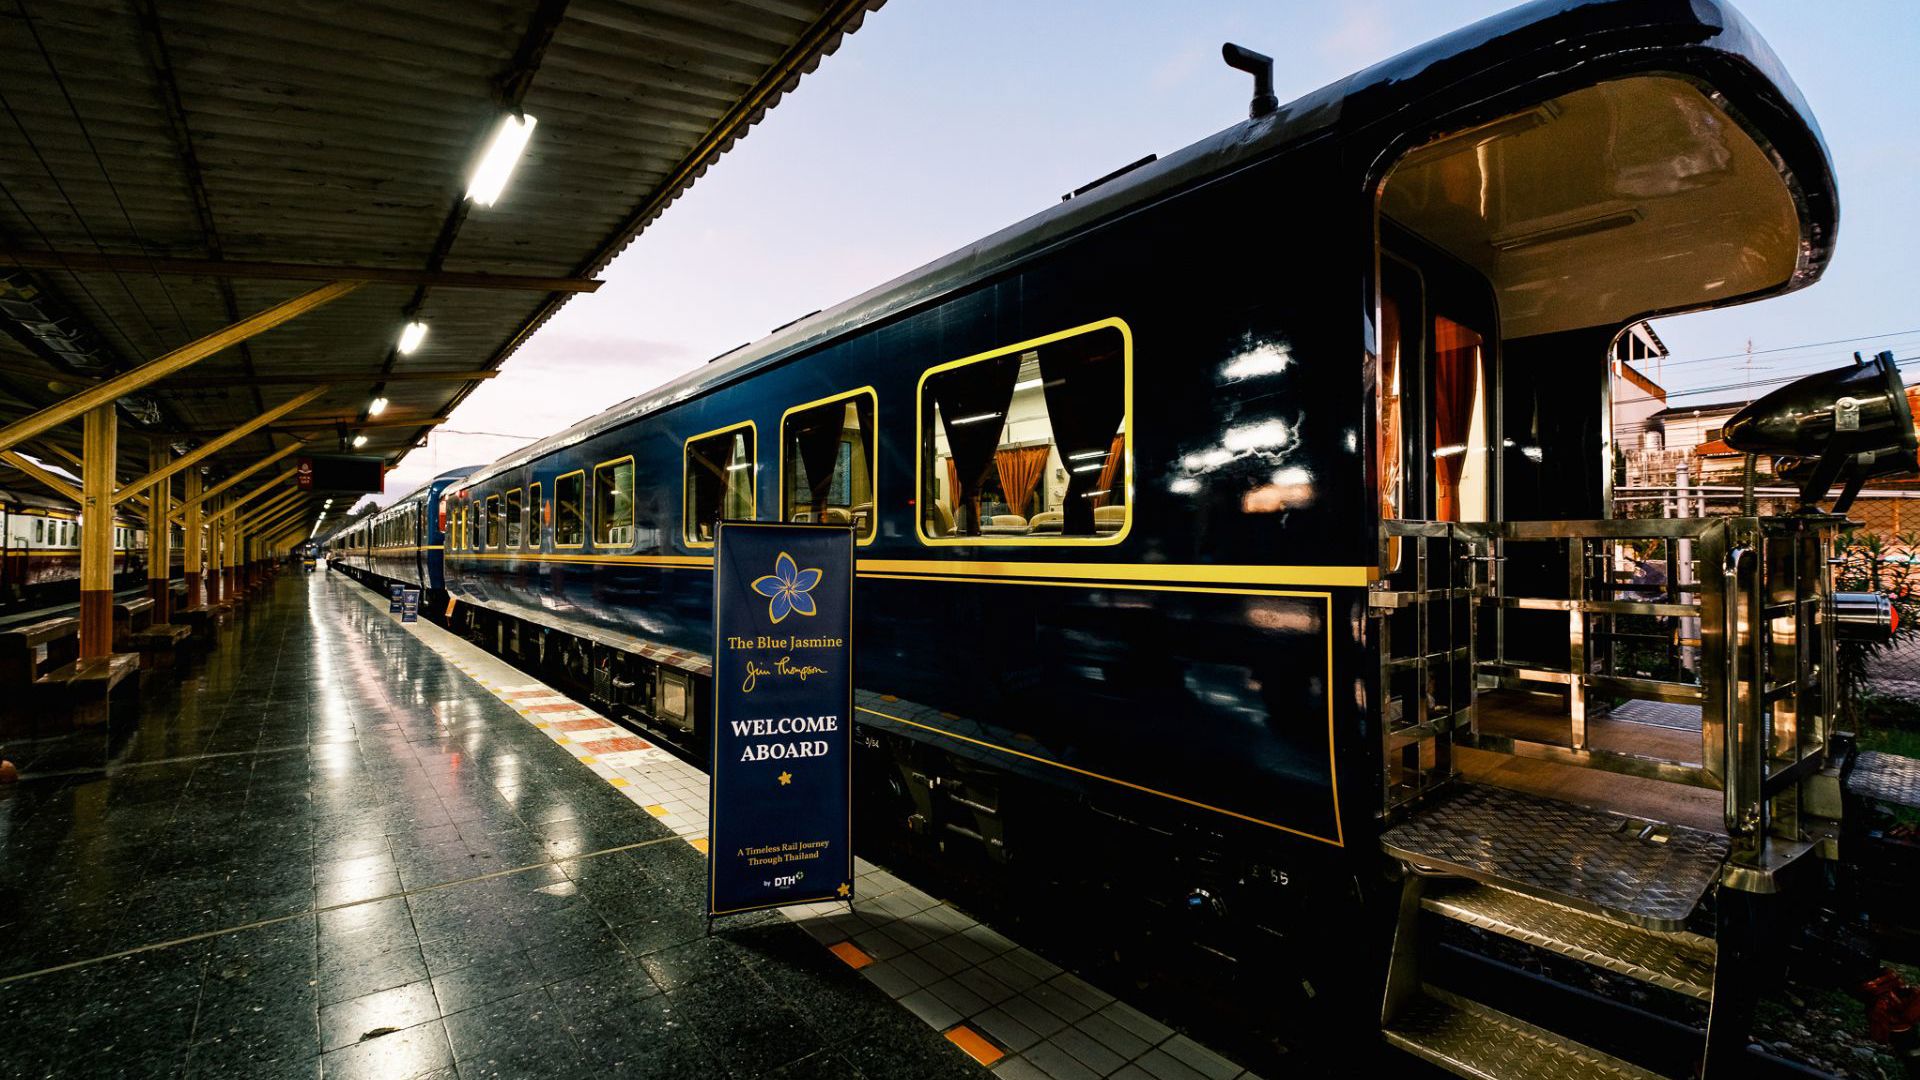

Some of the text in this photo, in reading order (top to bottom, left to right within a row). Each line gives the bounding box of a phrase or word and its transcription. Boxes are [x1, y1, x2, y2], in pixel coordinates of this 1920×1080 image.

[728, 635, 843, 651] The Blue Jasmine
[742, 656, 828, 693] Jim Thompson
[731, 715, 838, 737] WELCOME
[740, 740, 829, 762] ABOARD
[737, 840, 830, 857] A Timeless Rail Journey
[748, 851, 819, 866] Through Thailand
[763, 875, 796, 888] by DTH
